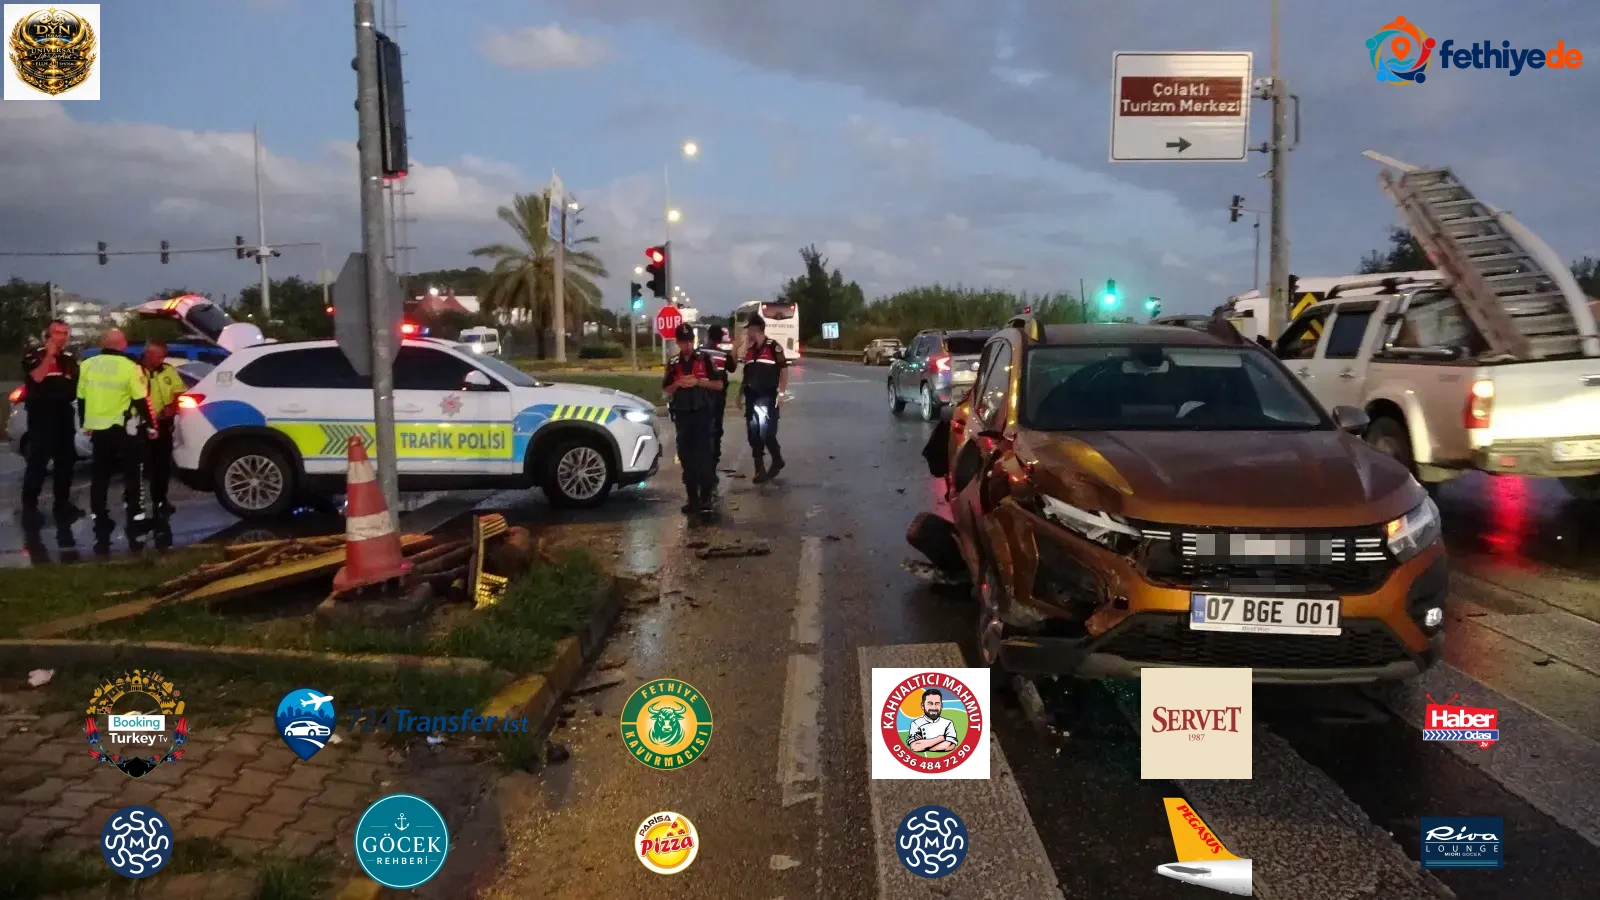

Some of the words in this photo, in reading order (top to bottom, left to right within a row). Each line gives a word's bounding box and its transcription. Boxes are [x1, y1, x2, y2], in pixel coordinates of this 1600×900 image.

[1153, 83, 1210, 98] Çolaklı
[1121, 99, 1176, 112] Turizm
[1180, 99, 1240, 112] Merkezi
[658, 315, 682, 330] DUR
[400, 430, 453, 449] TRAFİK
[458, 430, 505, 449] POLİSİ
[1194, 610, 1205, 618] TR
[1206, 597, 1235, 621] 07
[1242, 599, 1284, 623] BGE
[1296, 602, 1334, 625] 001
